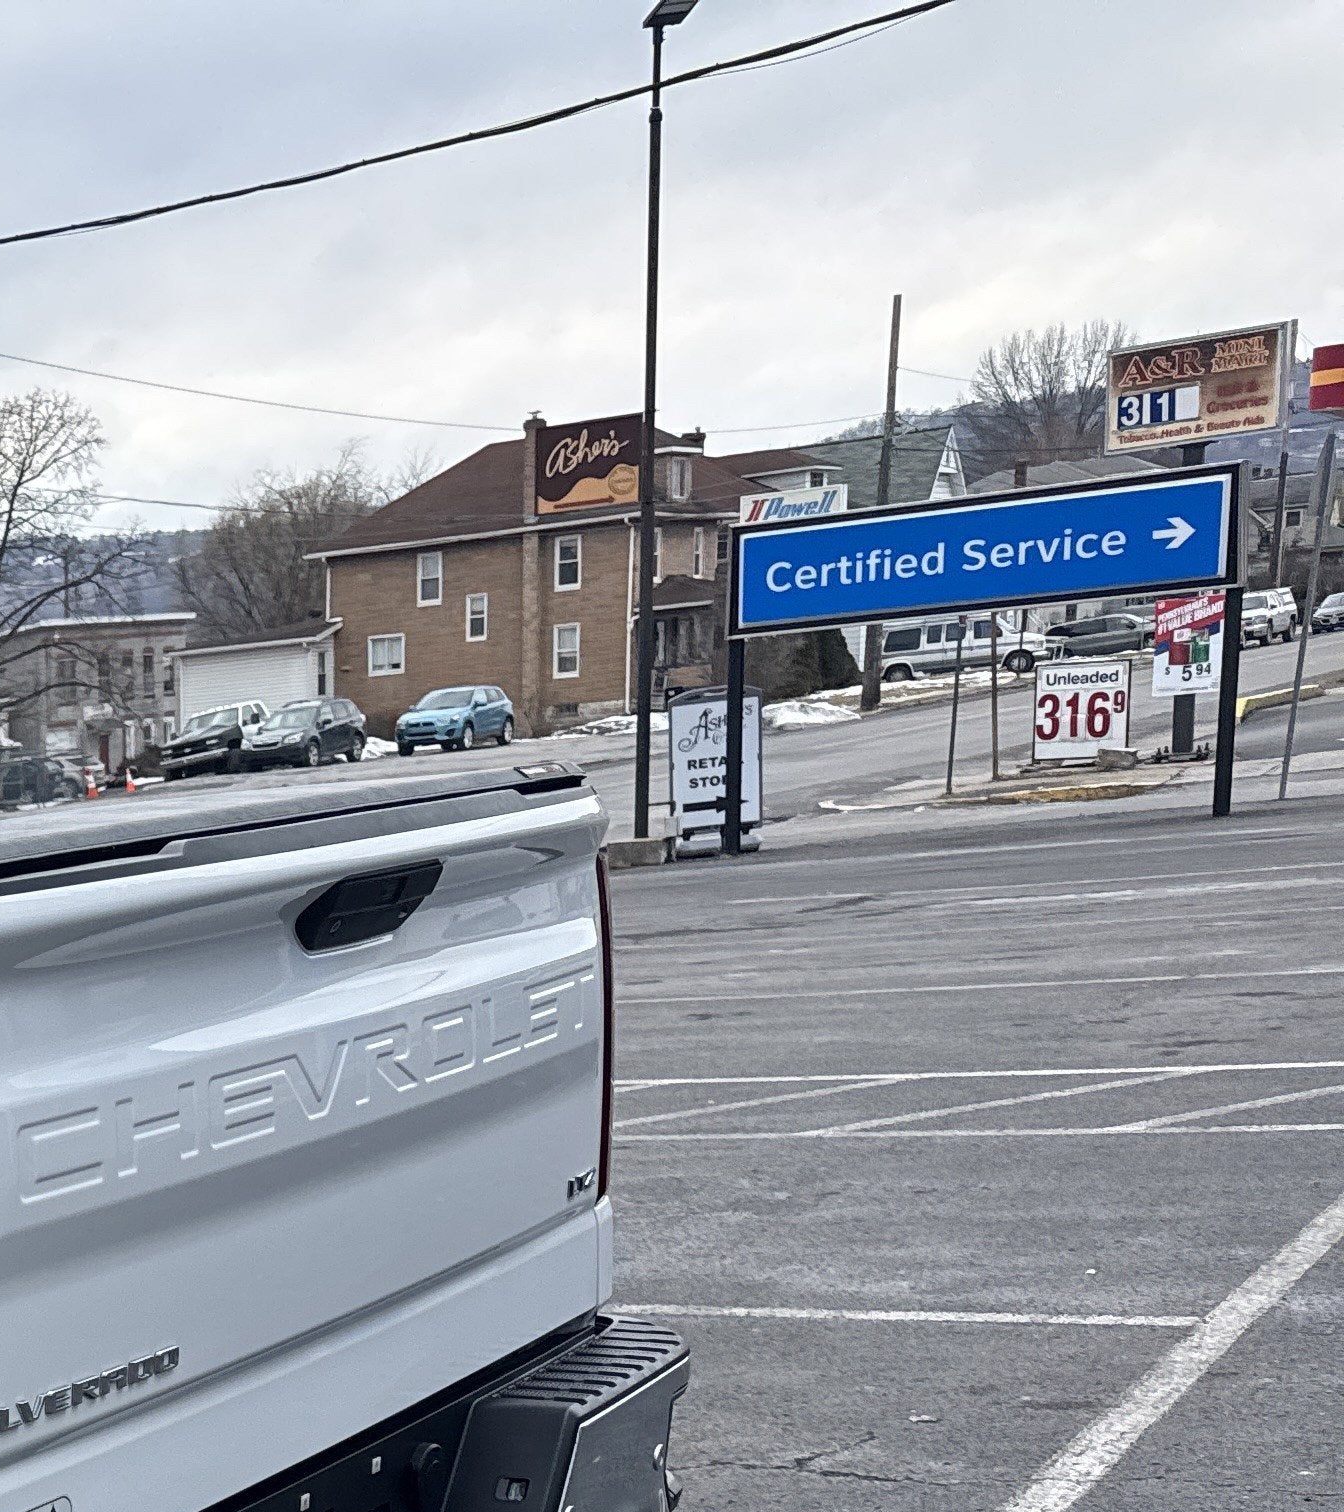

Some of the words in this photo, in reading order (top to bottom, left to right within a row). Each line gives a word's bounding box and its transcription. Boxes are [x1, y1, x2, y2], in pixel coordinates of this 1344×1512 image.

[1214, 336, 1266, 357] MINI
[1118, 348, 1205, 388] A&R
[1210, 349, 1270, 373] MART
[1159, 426, 1192, 439] Health
[1194, 423, 1205, 434] &
[1206, 419, 1241, 432] Beauty
[1243, 414, 1265, 427] Aids
[762, 490, 838, 521] Powell
[766, 541, 946, 593] Certified
[961, 528, 1127, 572] Service
[1046, 669, 1120, 687] Unleaded
[687, 756, 728, 771] RETA
[689, 774, 728, 789] STO
[15, 965, 595, 1204] CHEVROLET
